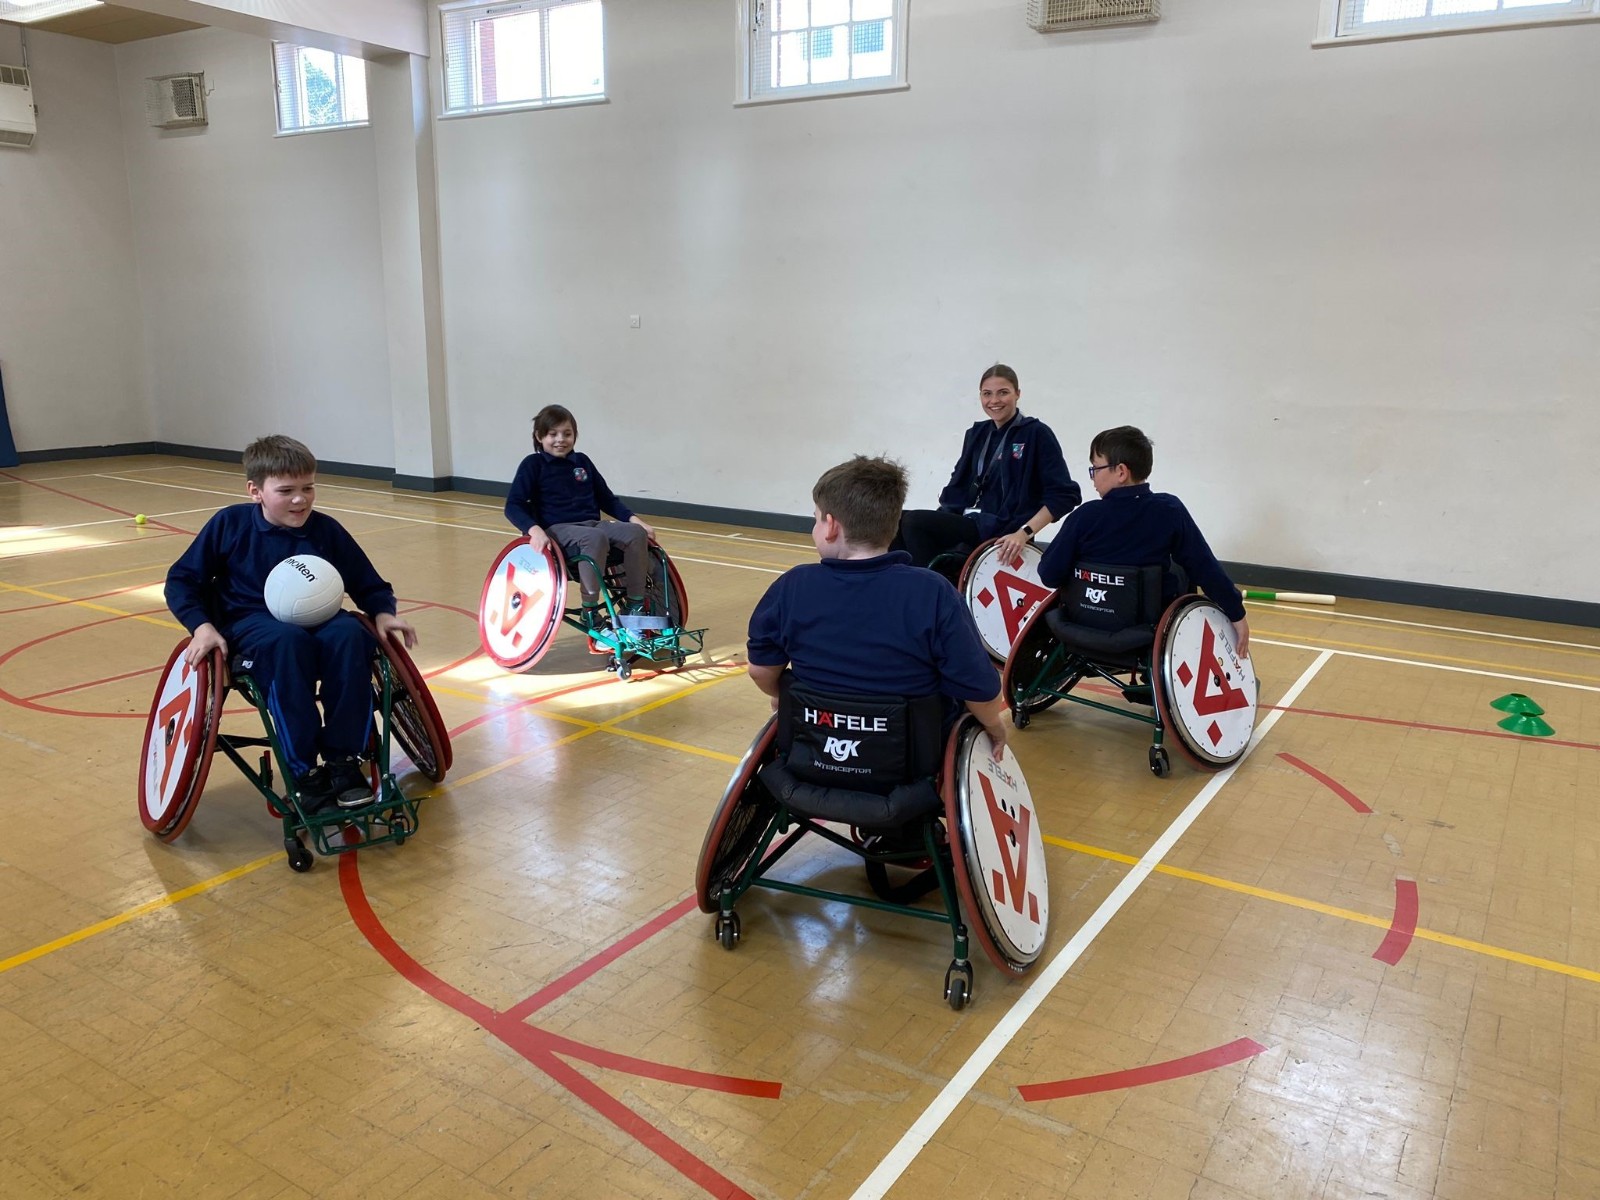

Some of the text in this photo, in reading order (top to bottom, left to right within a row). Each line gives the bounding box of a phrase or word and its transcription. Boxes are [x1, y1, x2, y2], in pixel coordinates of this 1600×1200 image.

[1074, 568, 1125, 586] HÄFELE
[804, 707, 888, 732] HÄFELE
[813, 760, 872, 774] INTERCEPTOR
